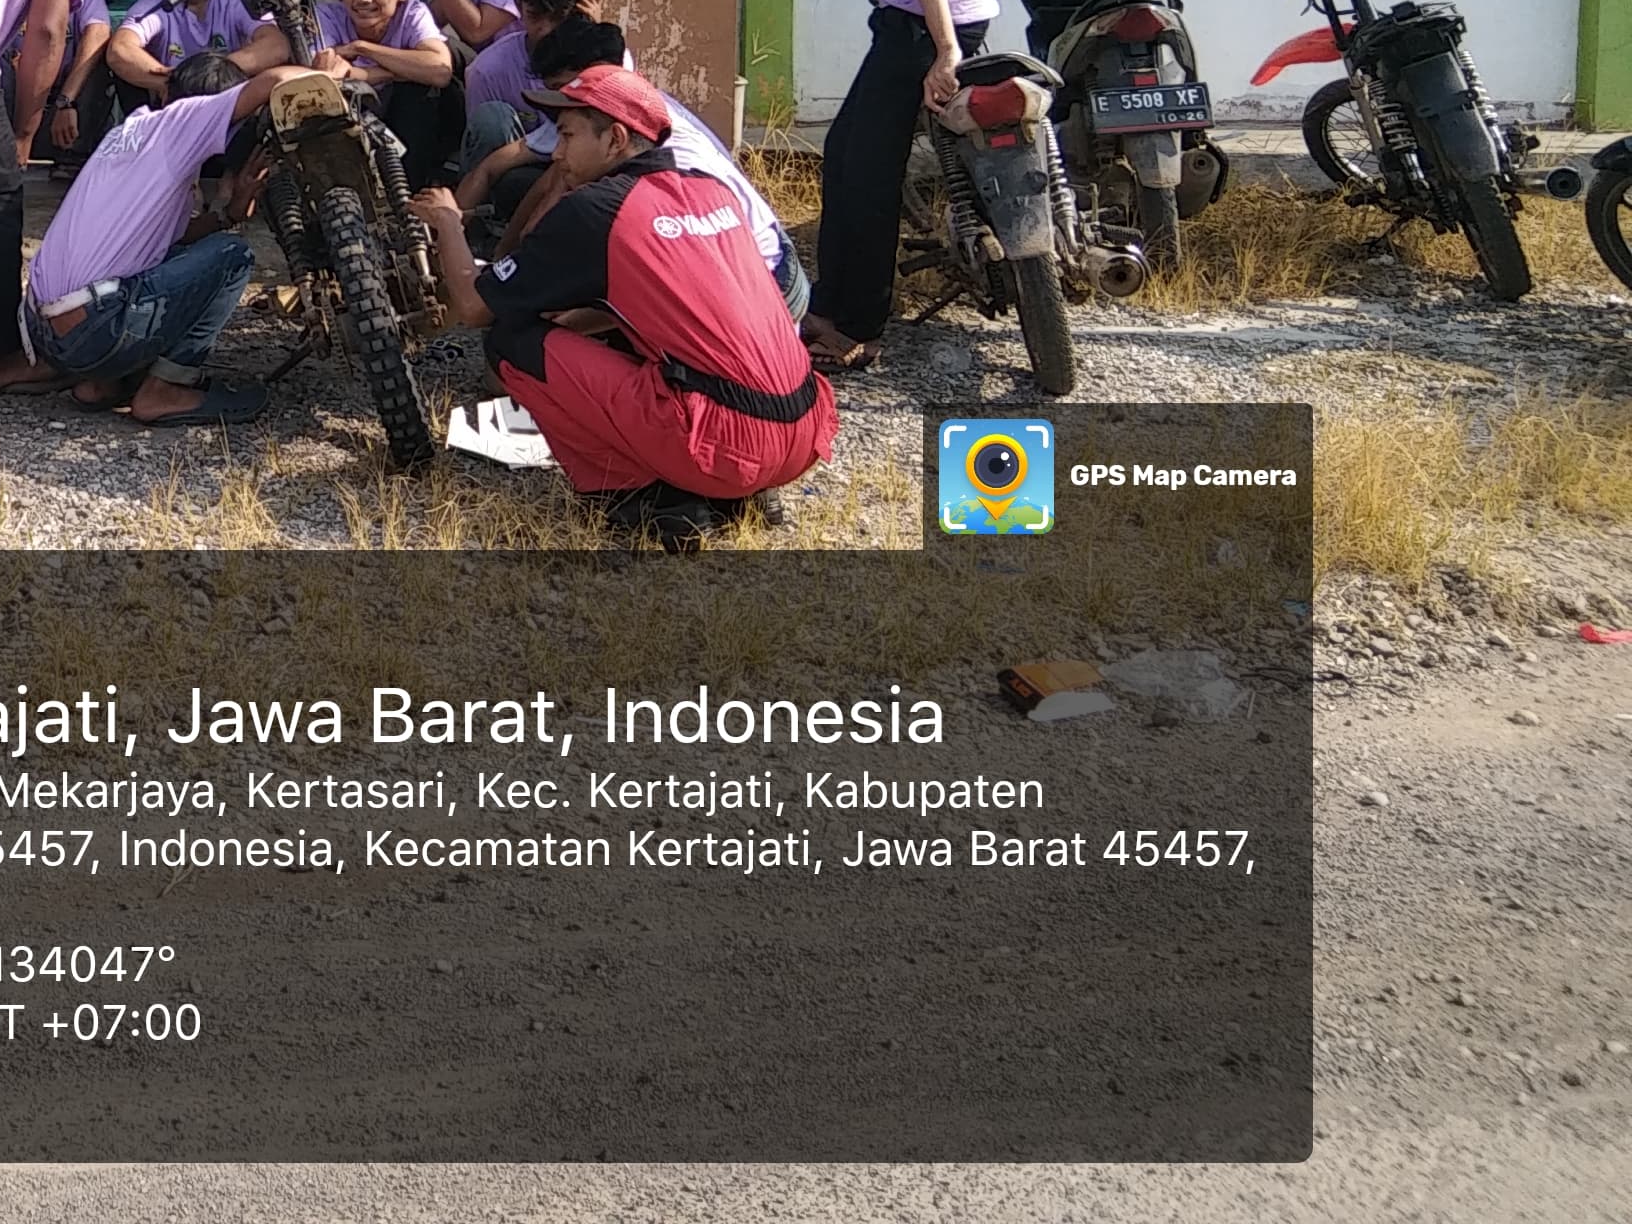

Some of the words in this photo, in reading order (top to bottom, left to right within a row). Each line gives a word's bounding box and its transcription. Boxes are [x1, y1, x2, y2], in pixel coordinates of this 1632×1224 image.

[1097, 96, 1110, 112] E
[1120, 92, 1165, 109] 5508
[1175, 88, 1200, 106] XF
